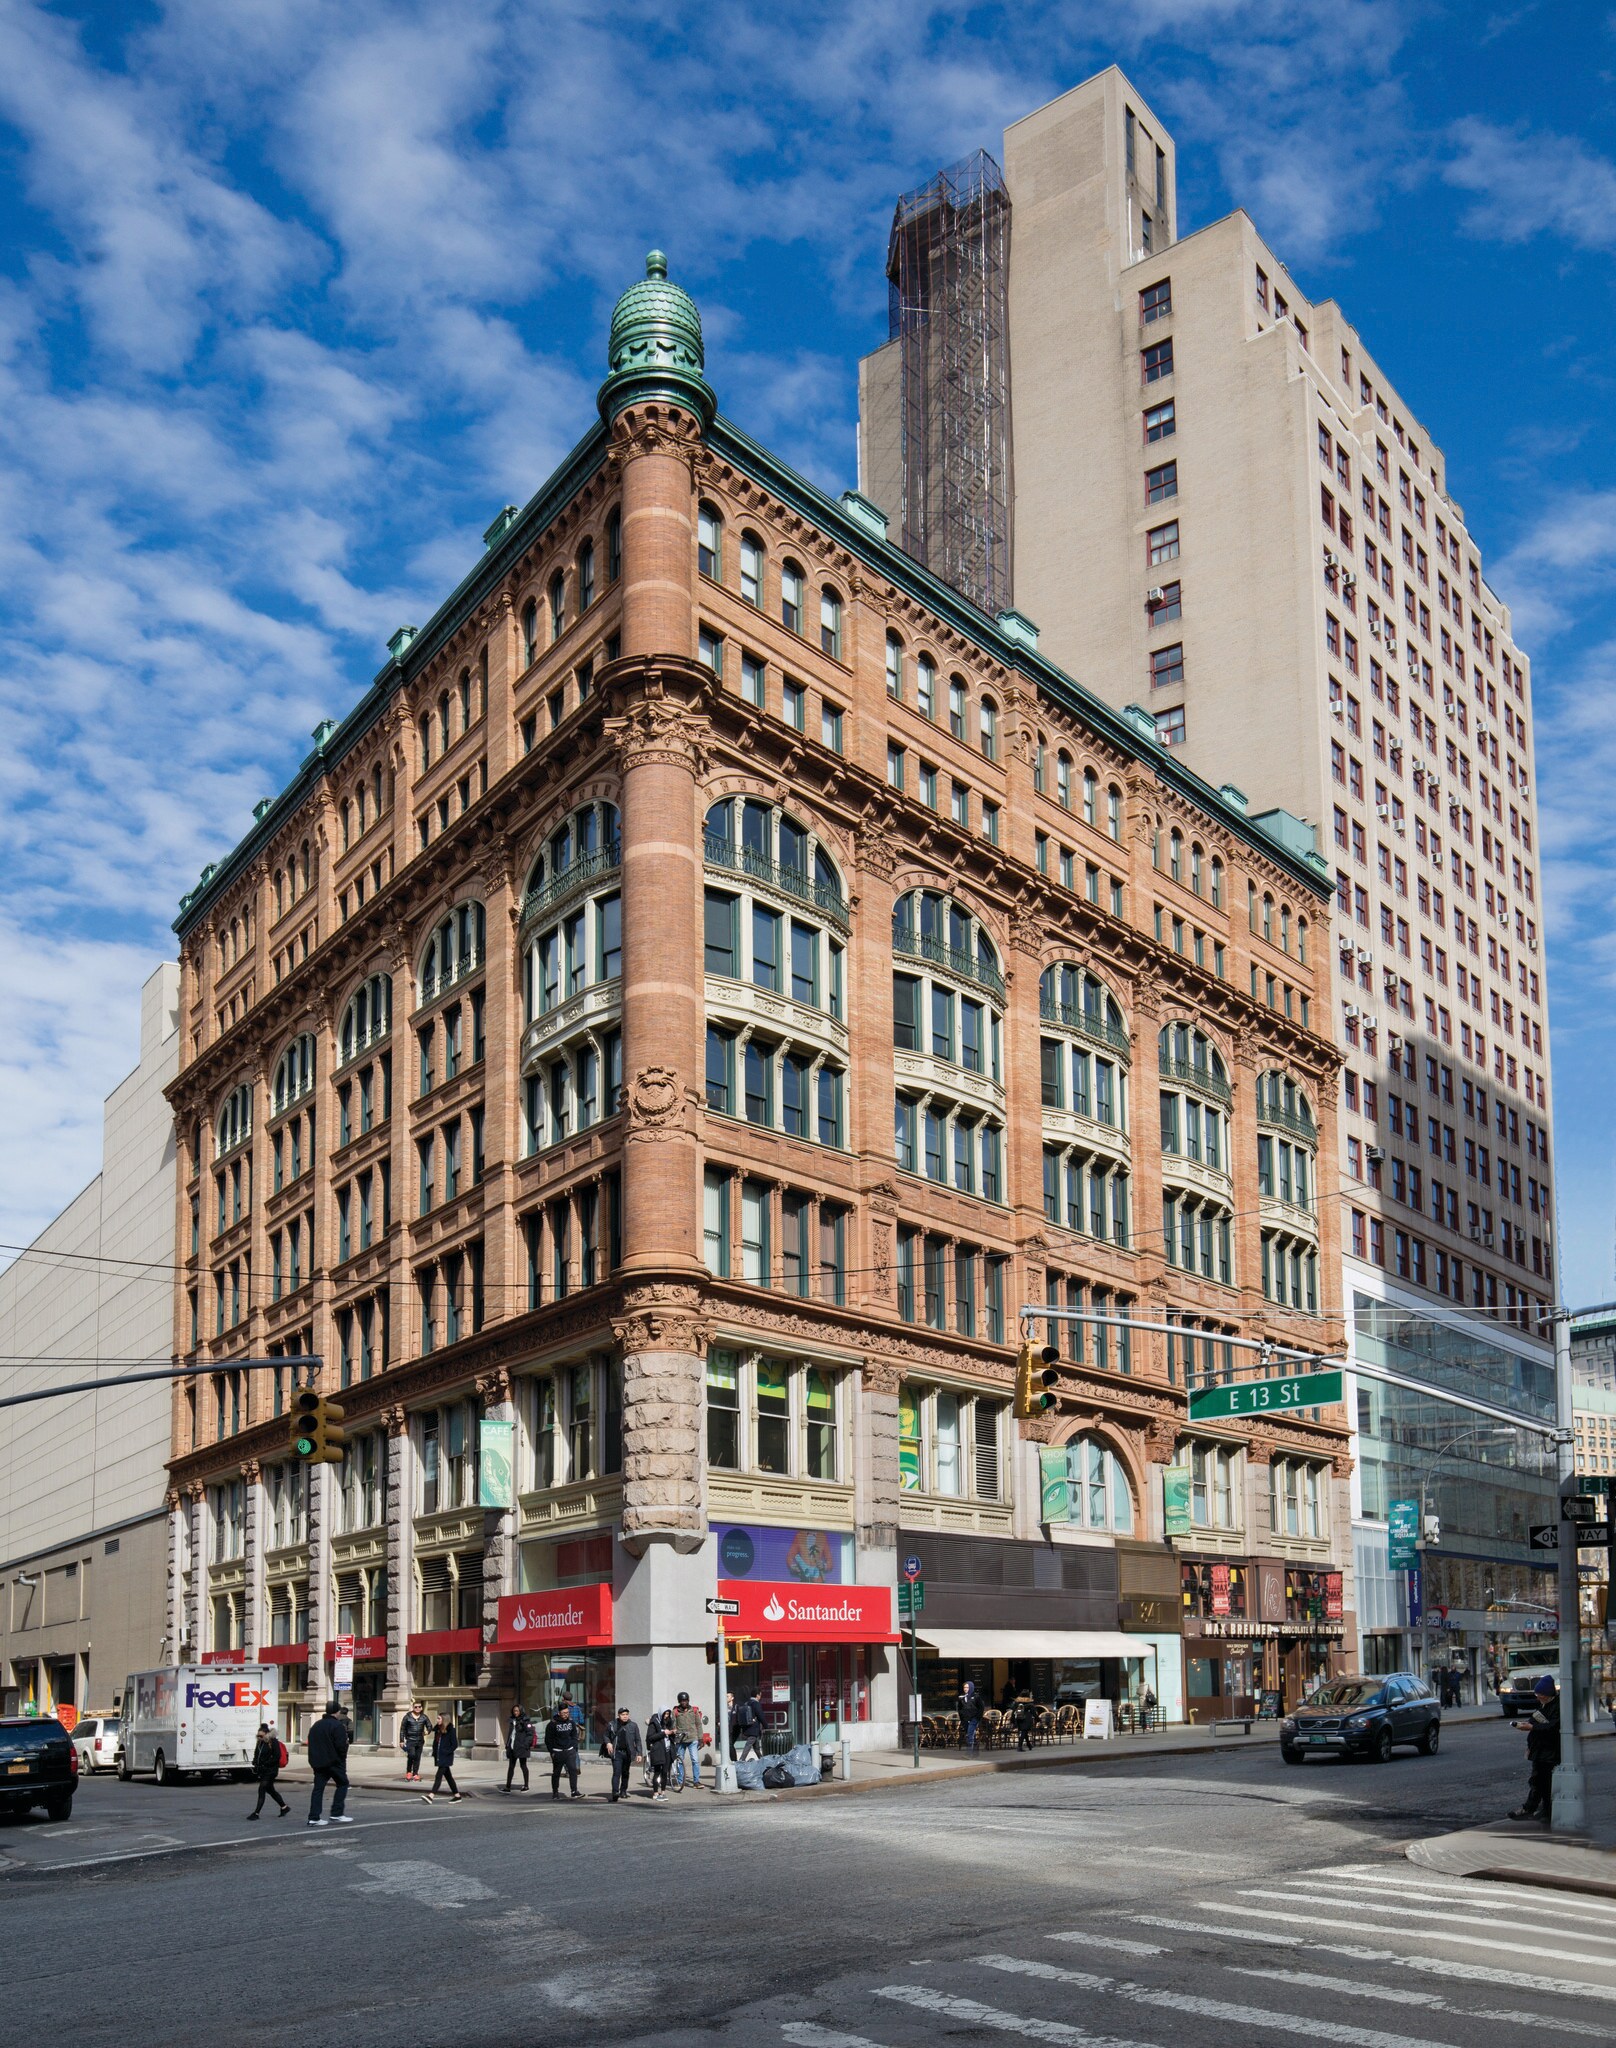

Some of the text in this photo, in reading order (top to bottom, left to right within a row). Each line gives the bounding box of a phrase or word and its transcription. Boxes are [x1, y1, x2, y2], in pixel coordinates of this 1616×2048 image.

[1230, 1382, 1300, 1410] E 13 St
[483, 1426, 509, 1436] CAFÉ
[1043, 1450, 1065, 1460] SHOP
[1166, 1471, 1188, 1479] YOGA
[1584, 1479, 1592, 1493] E
[1566, 1504, 1577, 1514] ONE
[1542, 1529, 1602, 1542] ON WAY
[710, 1602, 735, 1611] ONE WAY
[788, 1599, 862, 1622] Santander
[528, 1603, 584, 1629] Santander
[1205, 1624, 1226, 1635] MAX
[1230, 1624, 1272, 1635] BRENNER
[1281, 1625, 1309, 1635] CHOCOLATE
[1317, 1625, 1325, 1635] THE
[186, 1682, 270, 1708] FedEx
